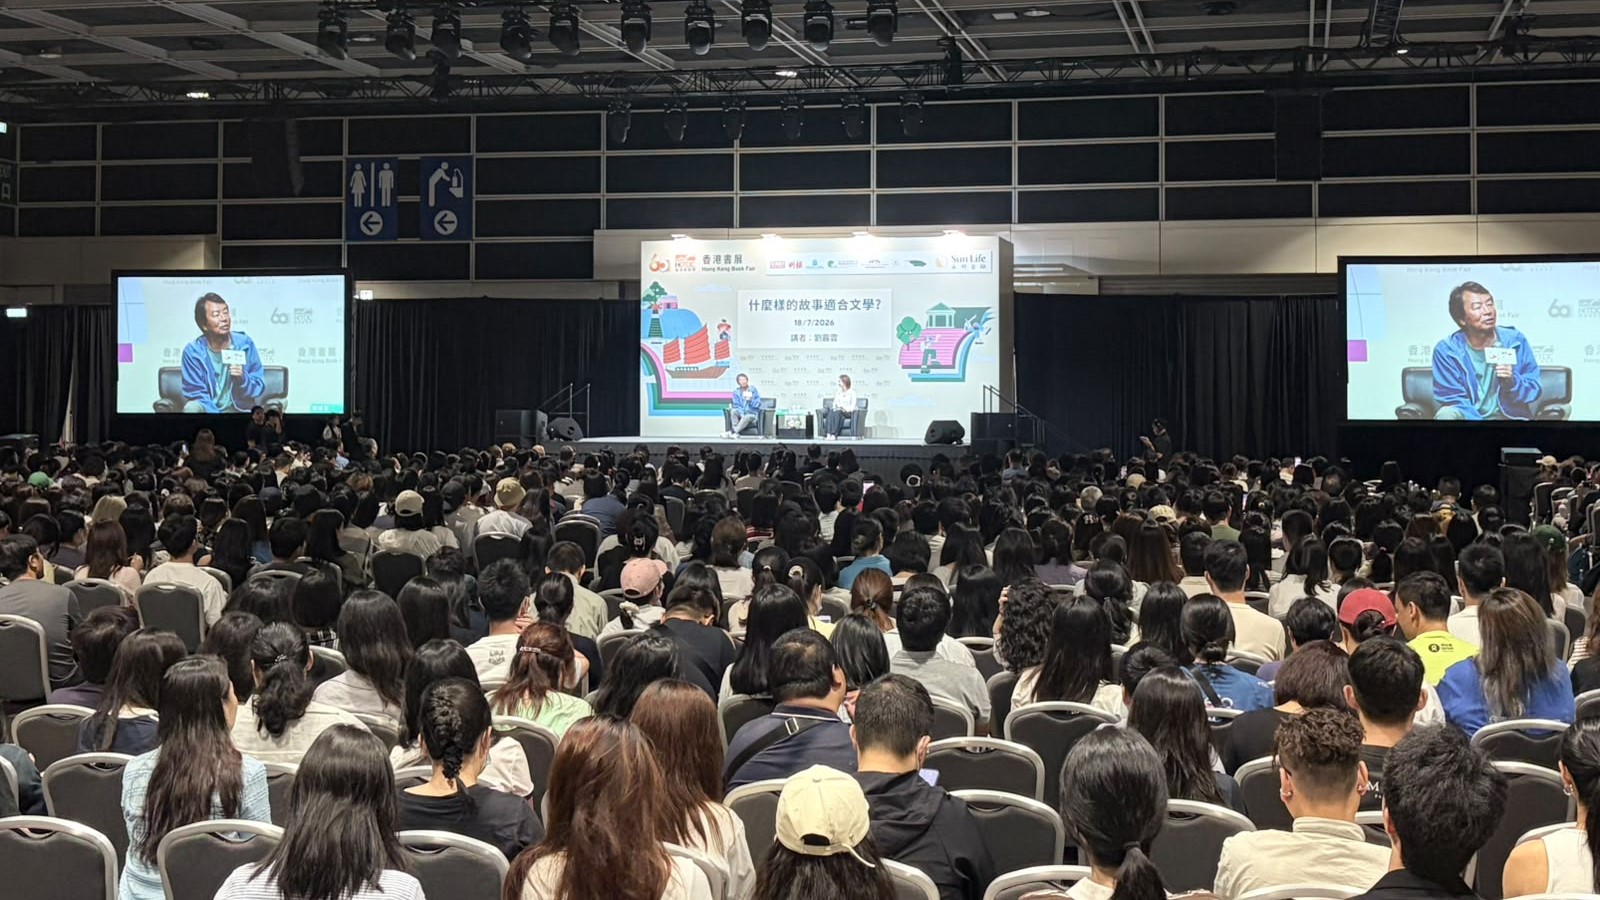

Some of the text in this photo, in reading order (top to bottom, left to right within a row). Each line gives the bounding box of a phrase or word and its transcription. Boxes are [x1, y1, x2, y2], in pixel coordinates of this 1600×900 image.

[702, 254, 743, 264] 香港書展
[951, 254, 986, 263] Sun Life
[749, 299, 881, 311] 什麼樣的故事適合文學?
